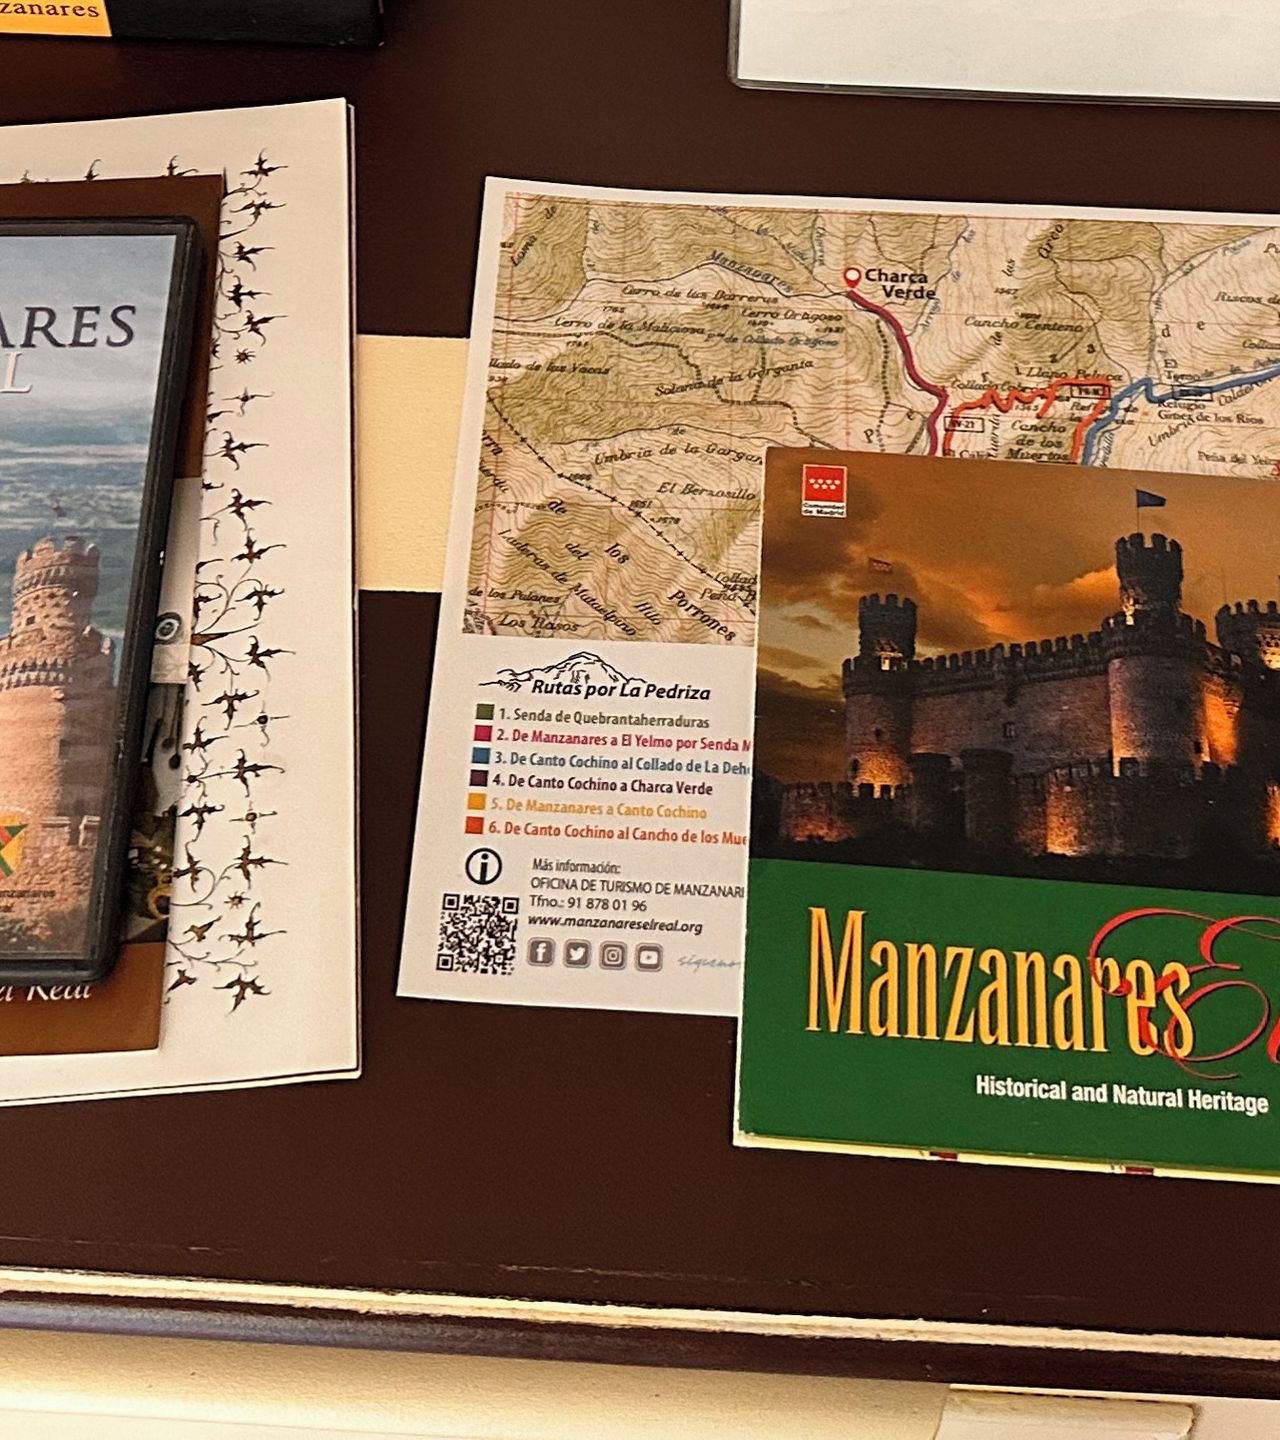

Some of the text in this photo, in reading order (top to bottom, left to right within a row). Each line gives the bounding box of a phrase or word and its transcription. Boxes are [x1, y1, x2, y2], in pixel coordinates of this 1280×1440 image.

[865, 268, 929, 284] Charca
[882, 284, 937, 300] Verde
[532, 679, 711, 701] Rutas por La Pedriza
[499, 708, 710, 729] 1. Senda de Quebrantaherraduras
[492, 773, 714, 796] 4. De Canto Cochino a Charca Verde
[567, 896, 582, 909] 91
[586, 898, 610, 911] 878
[612, 898, 627, 911] 01
[631, 900, 648, 912] 96
[527, 915, 703, 935] www.manzanareselreal.org
[805, 906, 1195, 1060] Manzanares
[975, 1072, 1270, 1117] Historical and Natural Heritage
